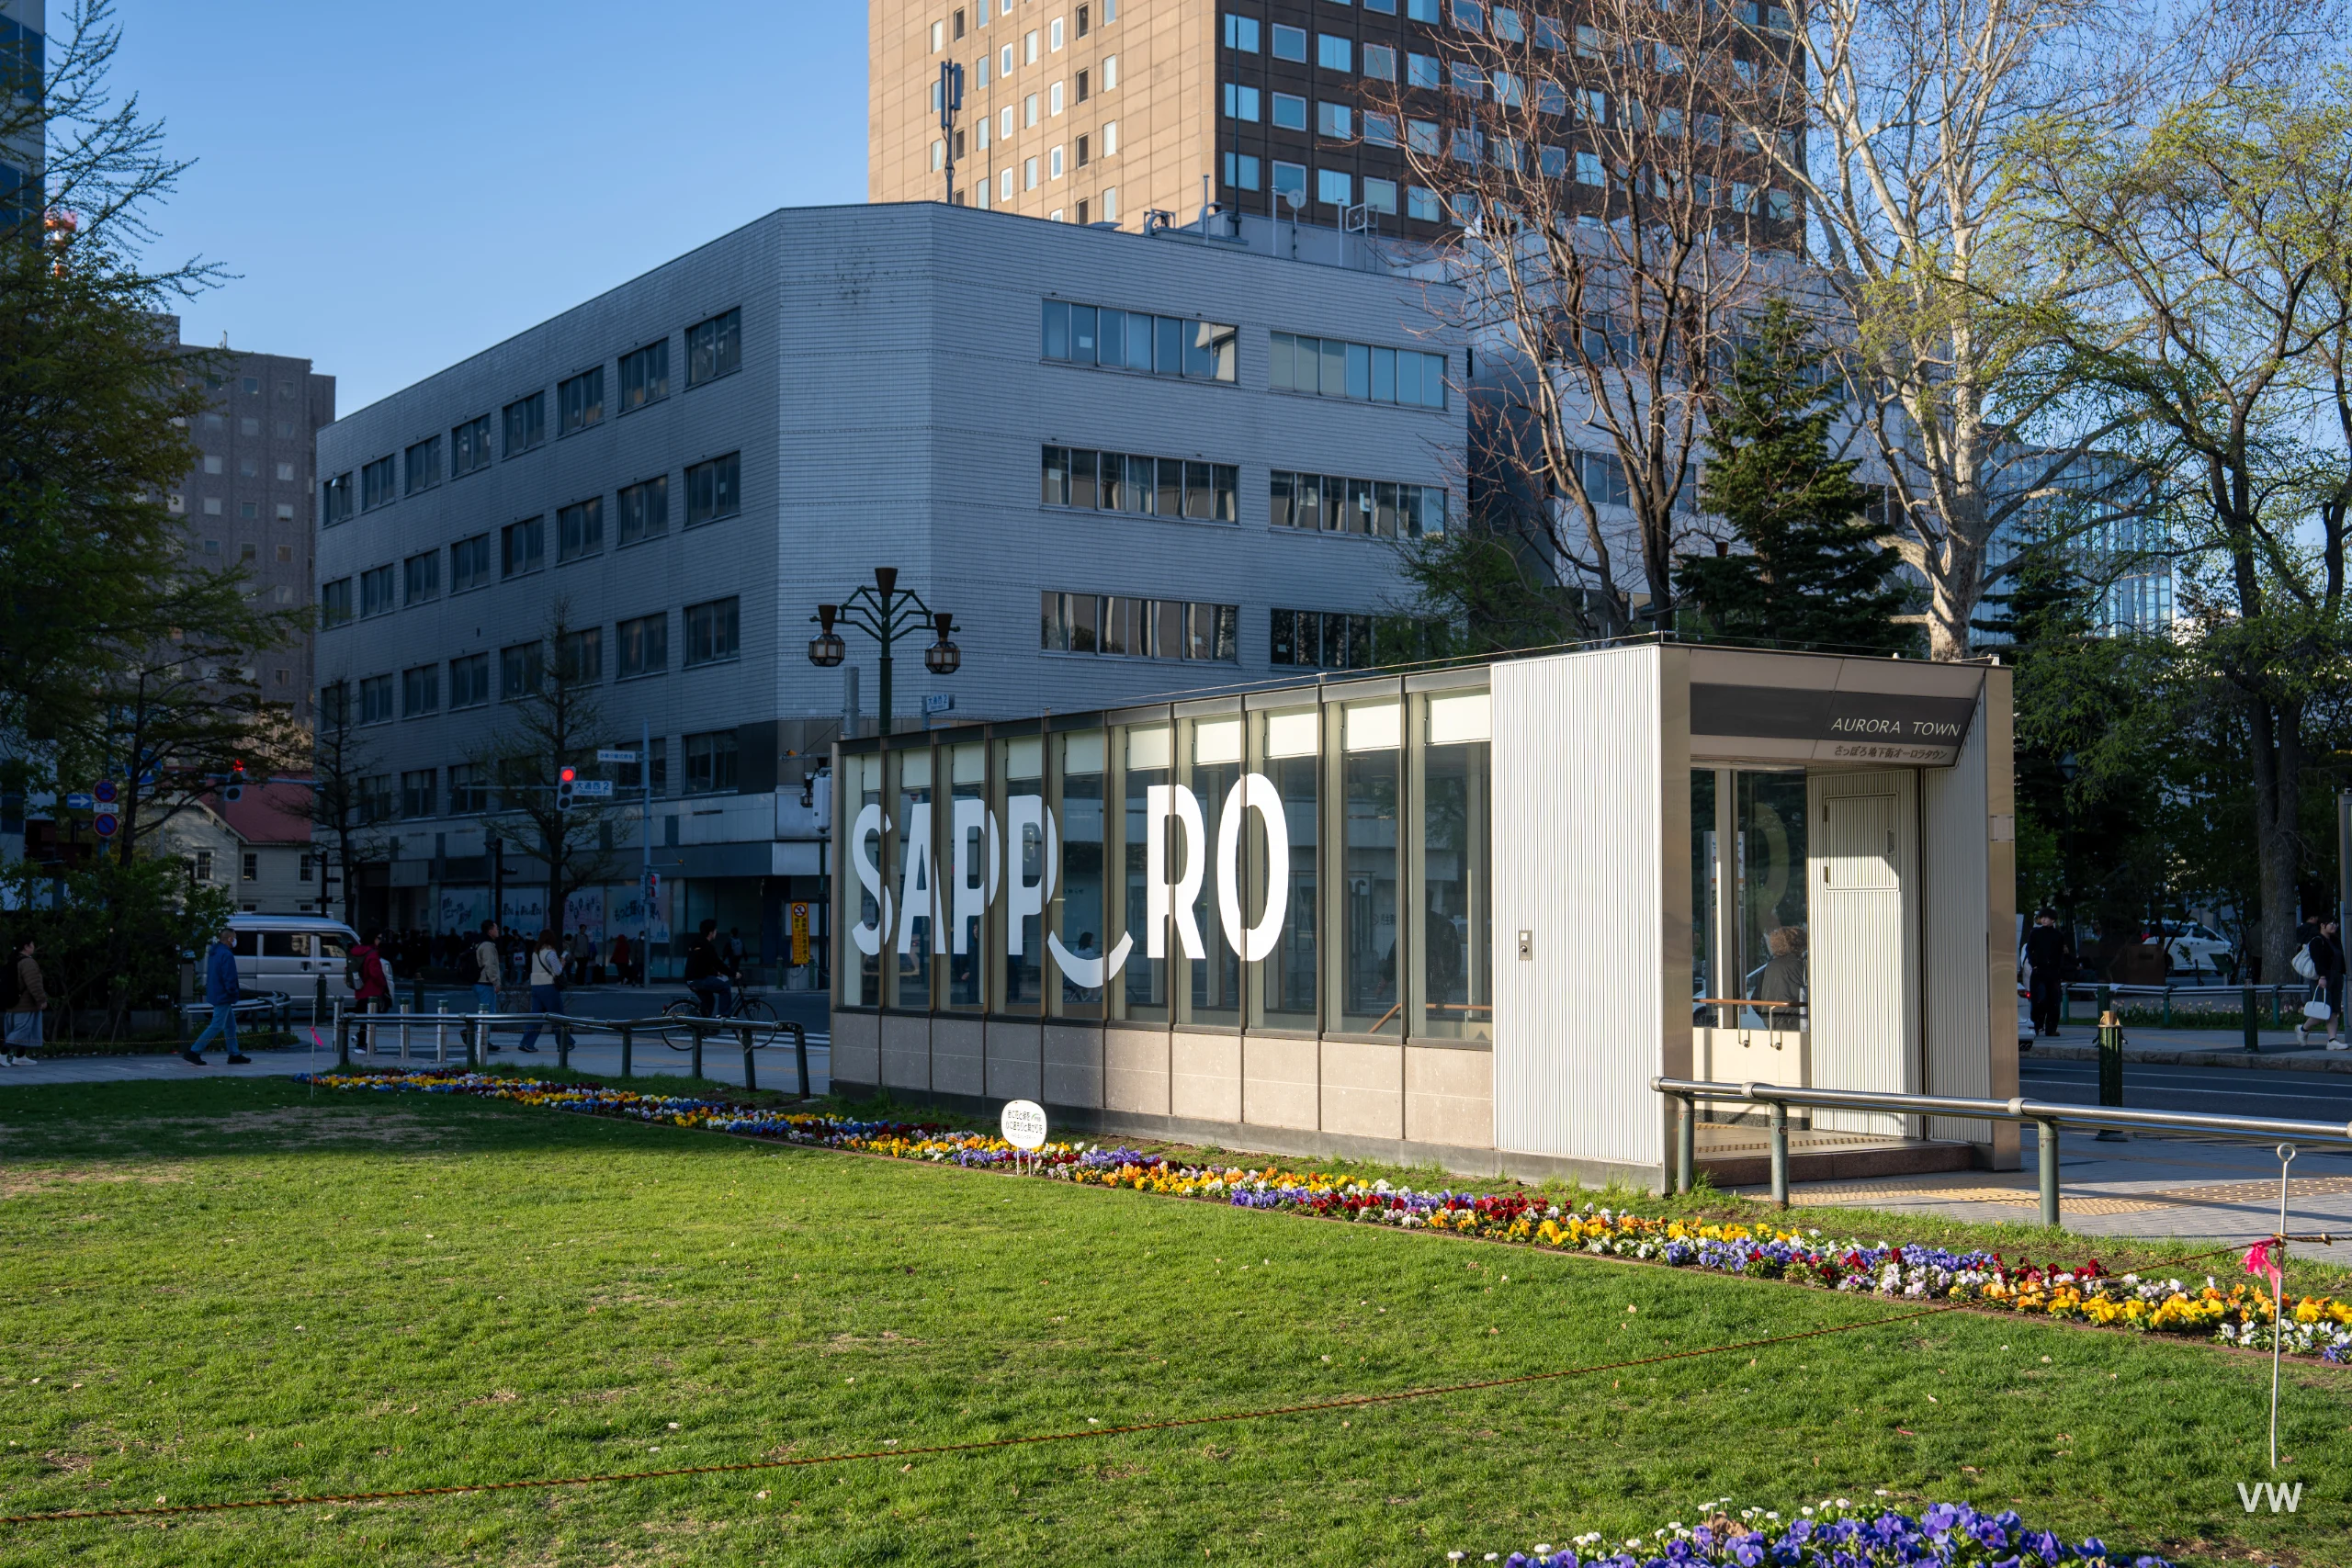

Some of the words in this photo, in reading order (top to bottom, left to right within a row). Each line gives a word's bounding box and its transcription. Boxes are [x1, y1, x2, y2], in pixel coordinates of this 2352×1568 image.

[1831, 718, 1900, 734] AURORA
[1913, 721, 1961, 737] TOWN
[1835, 745, 1948, 760] さっぽろ地下街オーロラタウン
